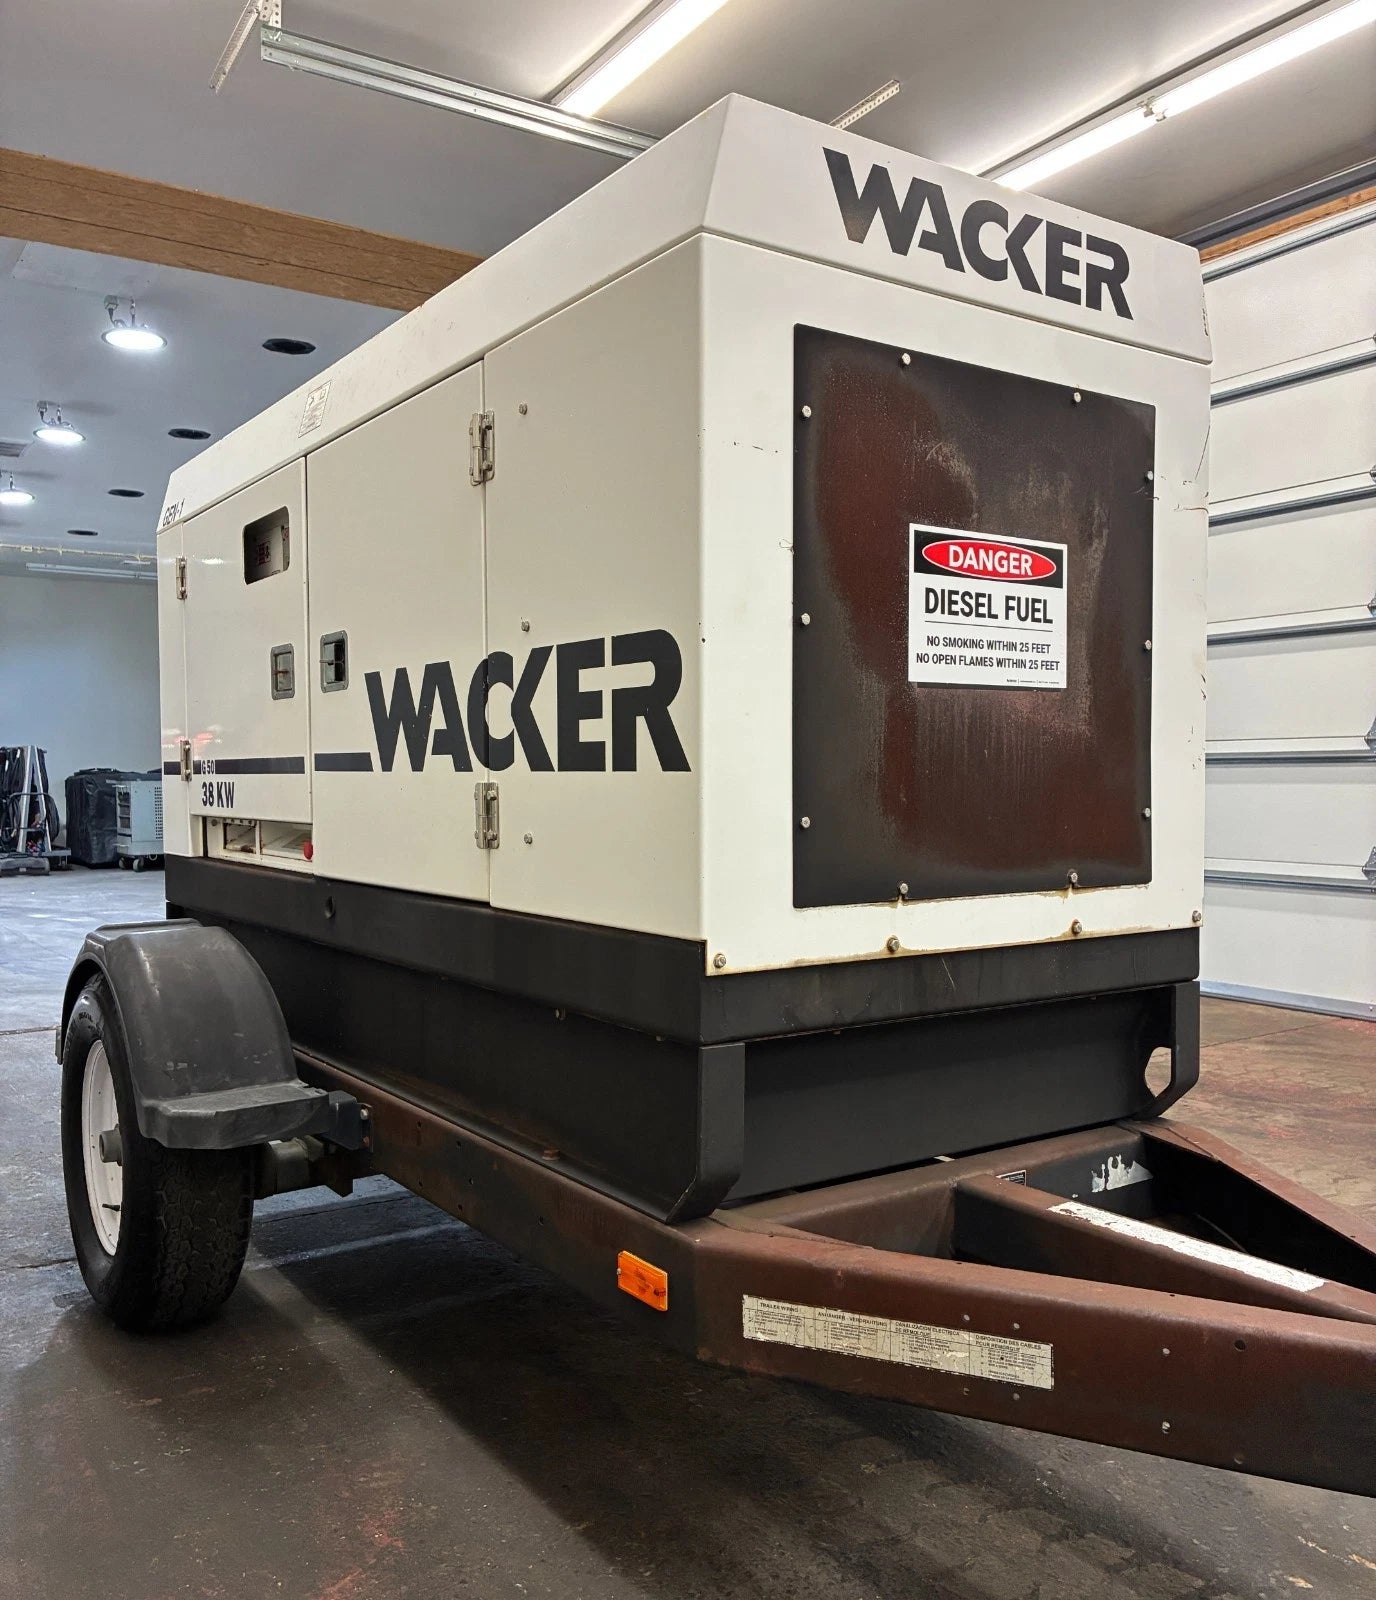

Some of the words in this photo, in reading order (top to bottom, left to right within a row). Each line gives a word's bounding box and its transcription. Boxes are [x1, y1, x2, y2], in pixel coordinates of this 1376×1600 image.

[822, 146, 1134, 320] WACKER
[949, 545, 1033, 576] DANGER
[925, 587, 999, 620] DIESEL
[1005, 595, 1053, 624] FUEL
[926, 635, 940, 647] NO
[942, 636, 984, 650] SMOKING
[986, 639, 1018, 652] WITHIN
[1019, 642, 1030, 653] 25
[1031, 643, 1051, 654] FEET
[916, 652, 930, 663] NO
[931, 653, 957, 666] OPEN
[958, 655, 994, 668] FLAMES
[996, 657, 1027, 670] WITHIN
[1028, 659, 1039, 670] 25
[1040, 660, 1060, 671] FEET
[364, 629, 692, 772] WACKER
[206, 760, 215, 774] 50
[201, 781, 215, 807] 38
[216, 781, 235, 808] KW
